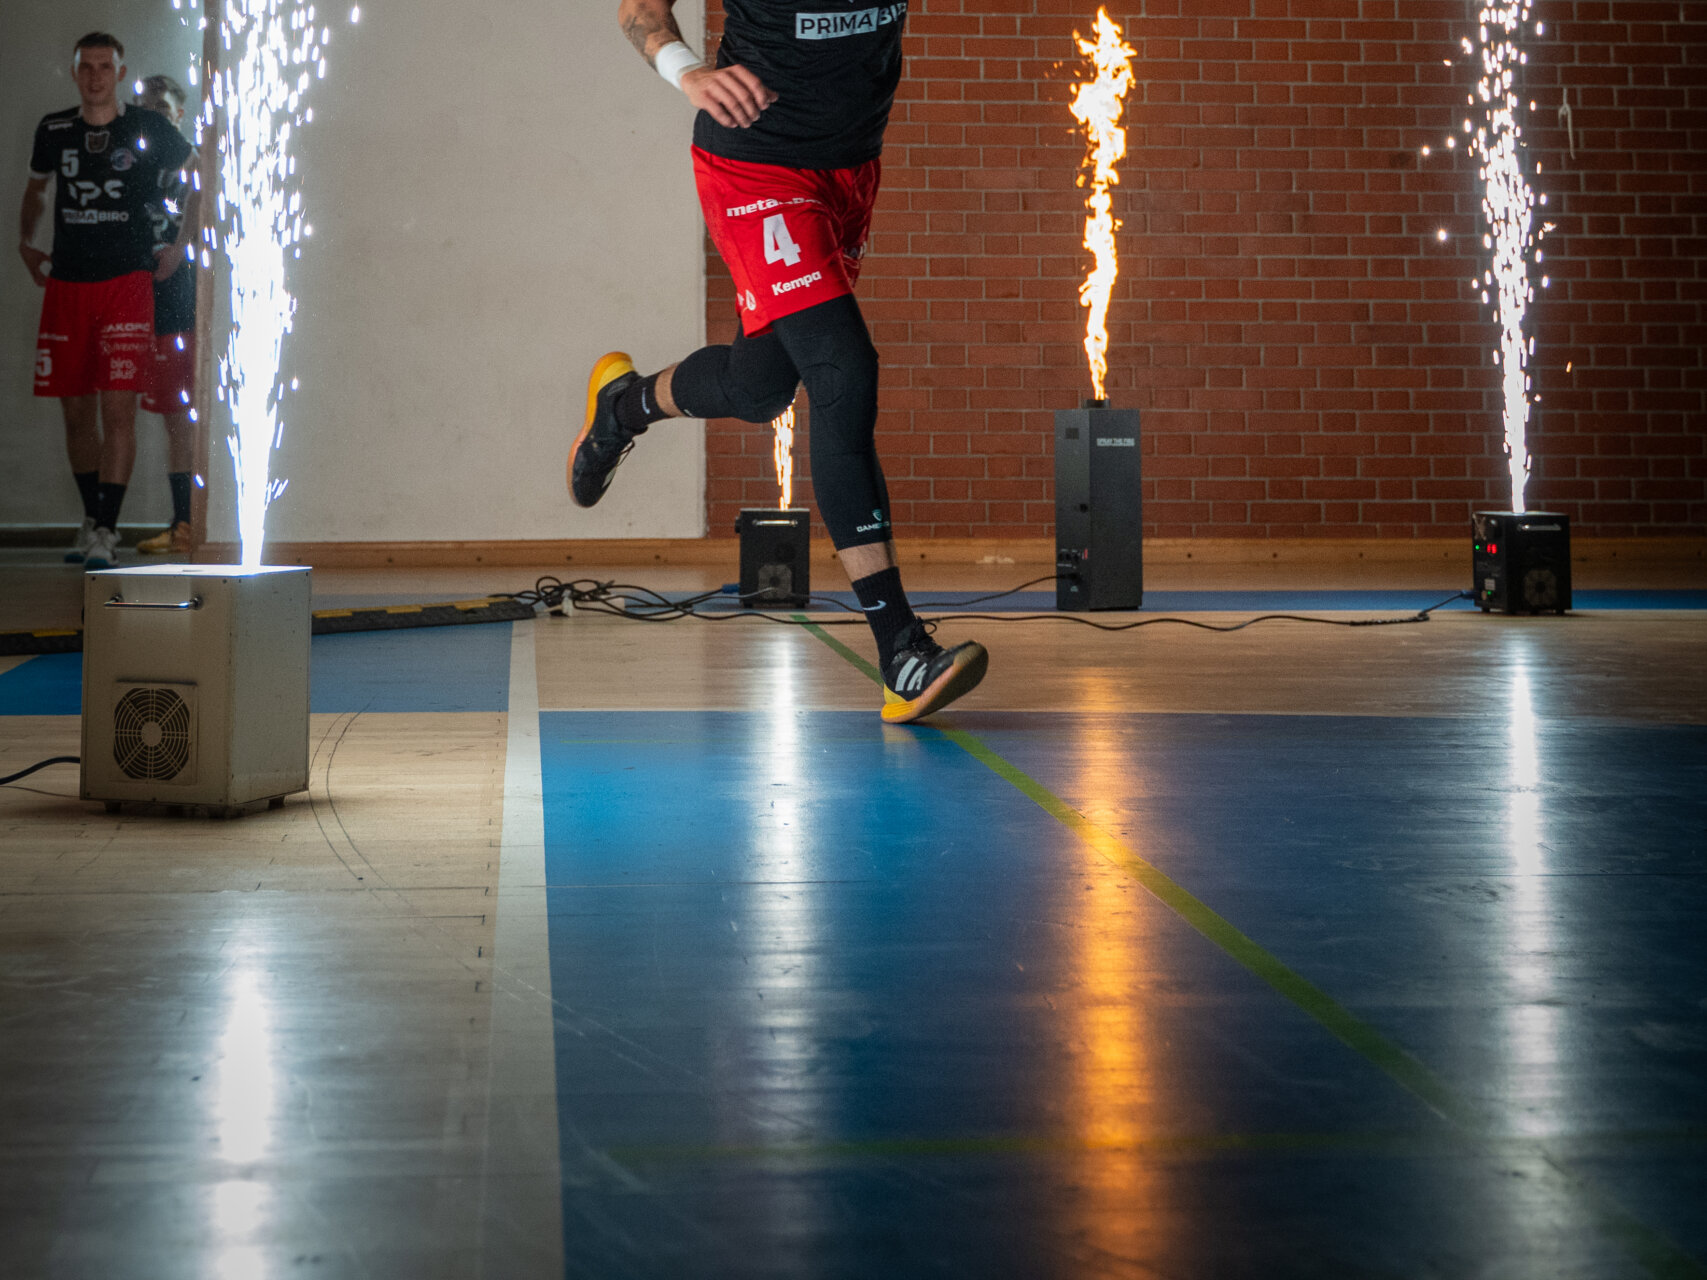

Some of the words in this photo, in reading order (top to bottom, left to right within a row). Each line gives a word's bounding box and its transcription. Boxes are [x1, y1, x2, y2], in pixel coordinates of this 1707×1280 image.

[60, 148, 79, 178] 5
[763, 213, 802, 267] 4
[771, 271, 823, 296] Kempa
